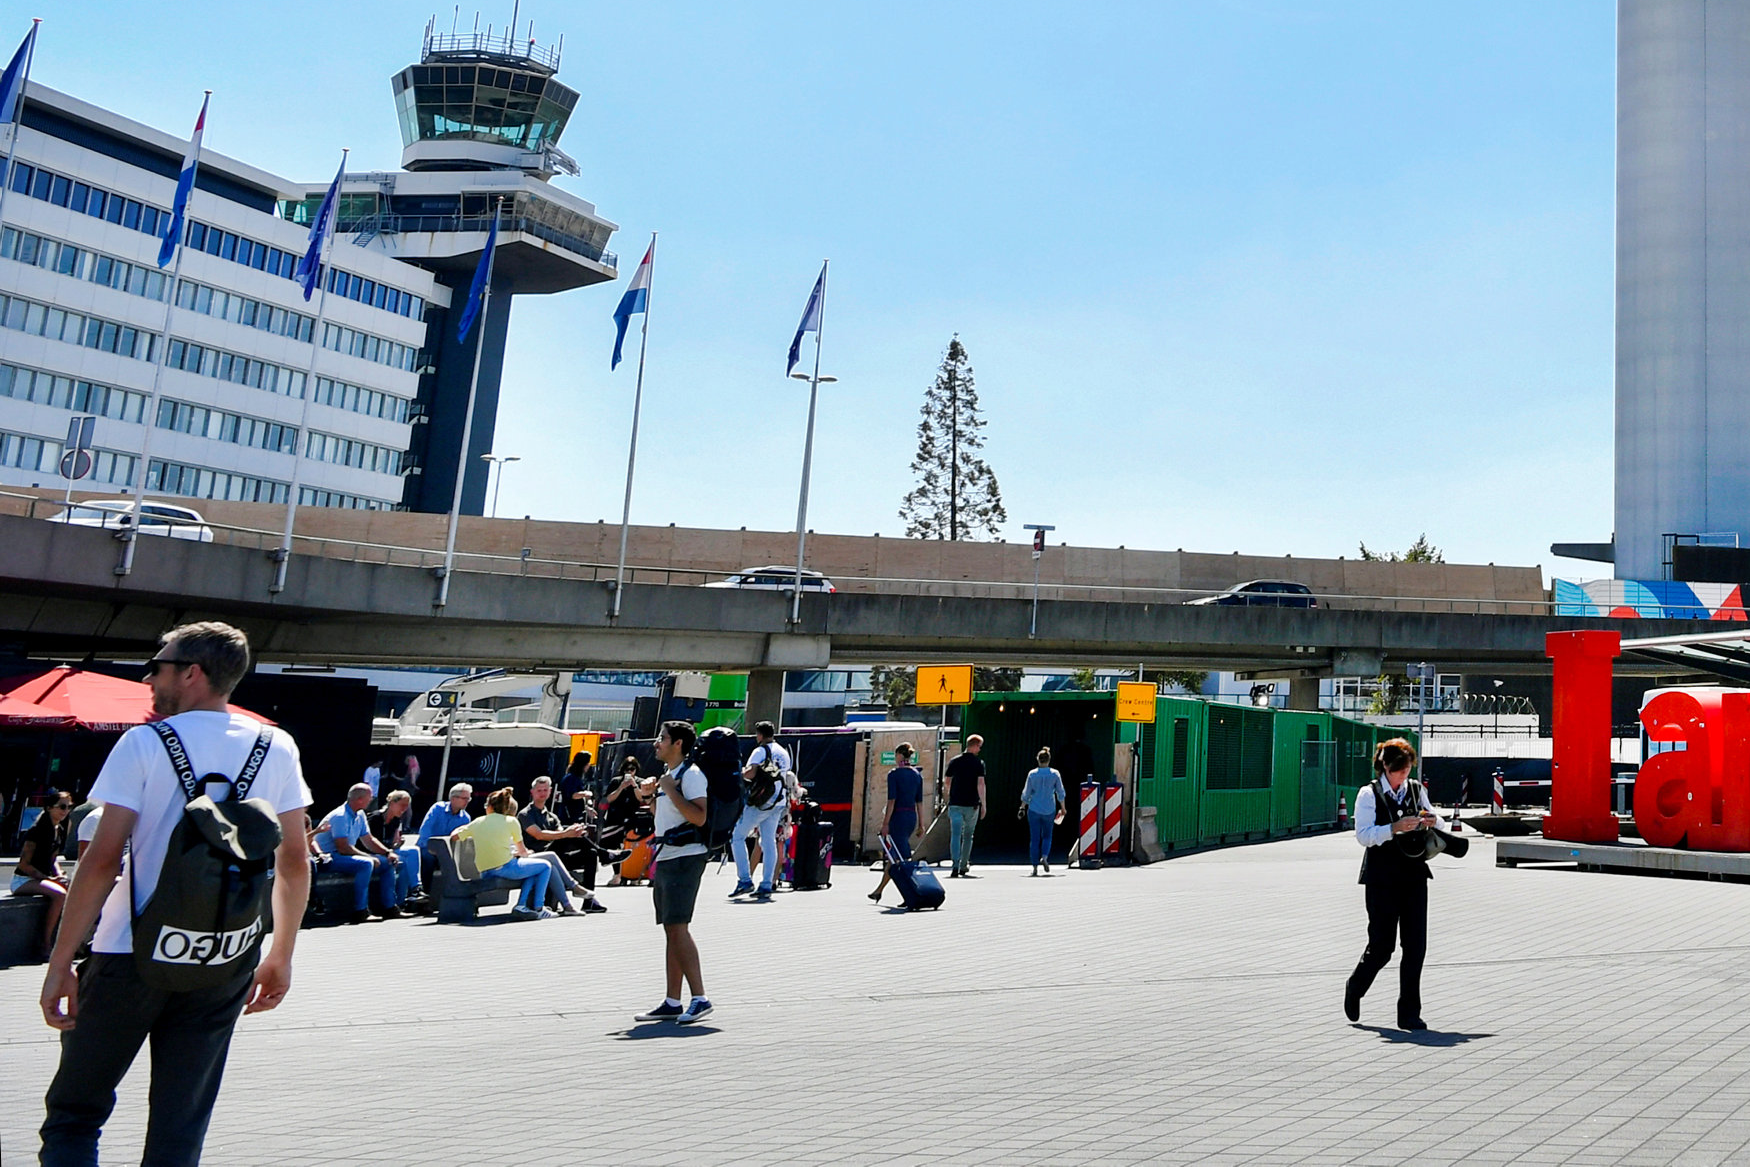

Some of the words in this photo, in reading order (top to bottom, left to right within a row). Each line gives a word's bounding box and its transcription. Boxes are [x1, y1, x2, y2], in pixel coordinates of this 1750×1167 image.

[93, 722, 121, 731] AMSTEL
[1543, 630, 1621, 842] I
[166, 736, 189, 770] HUGO
[242, 748, 264, 780] HUGO
